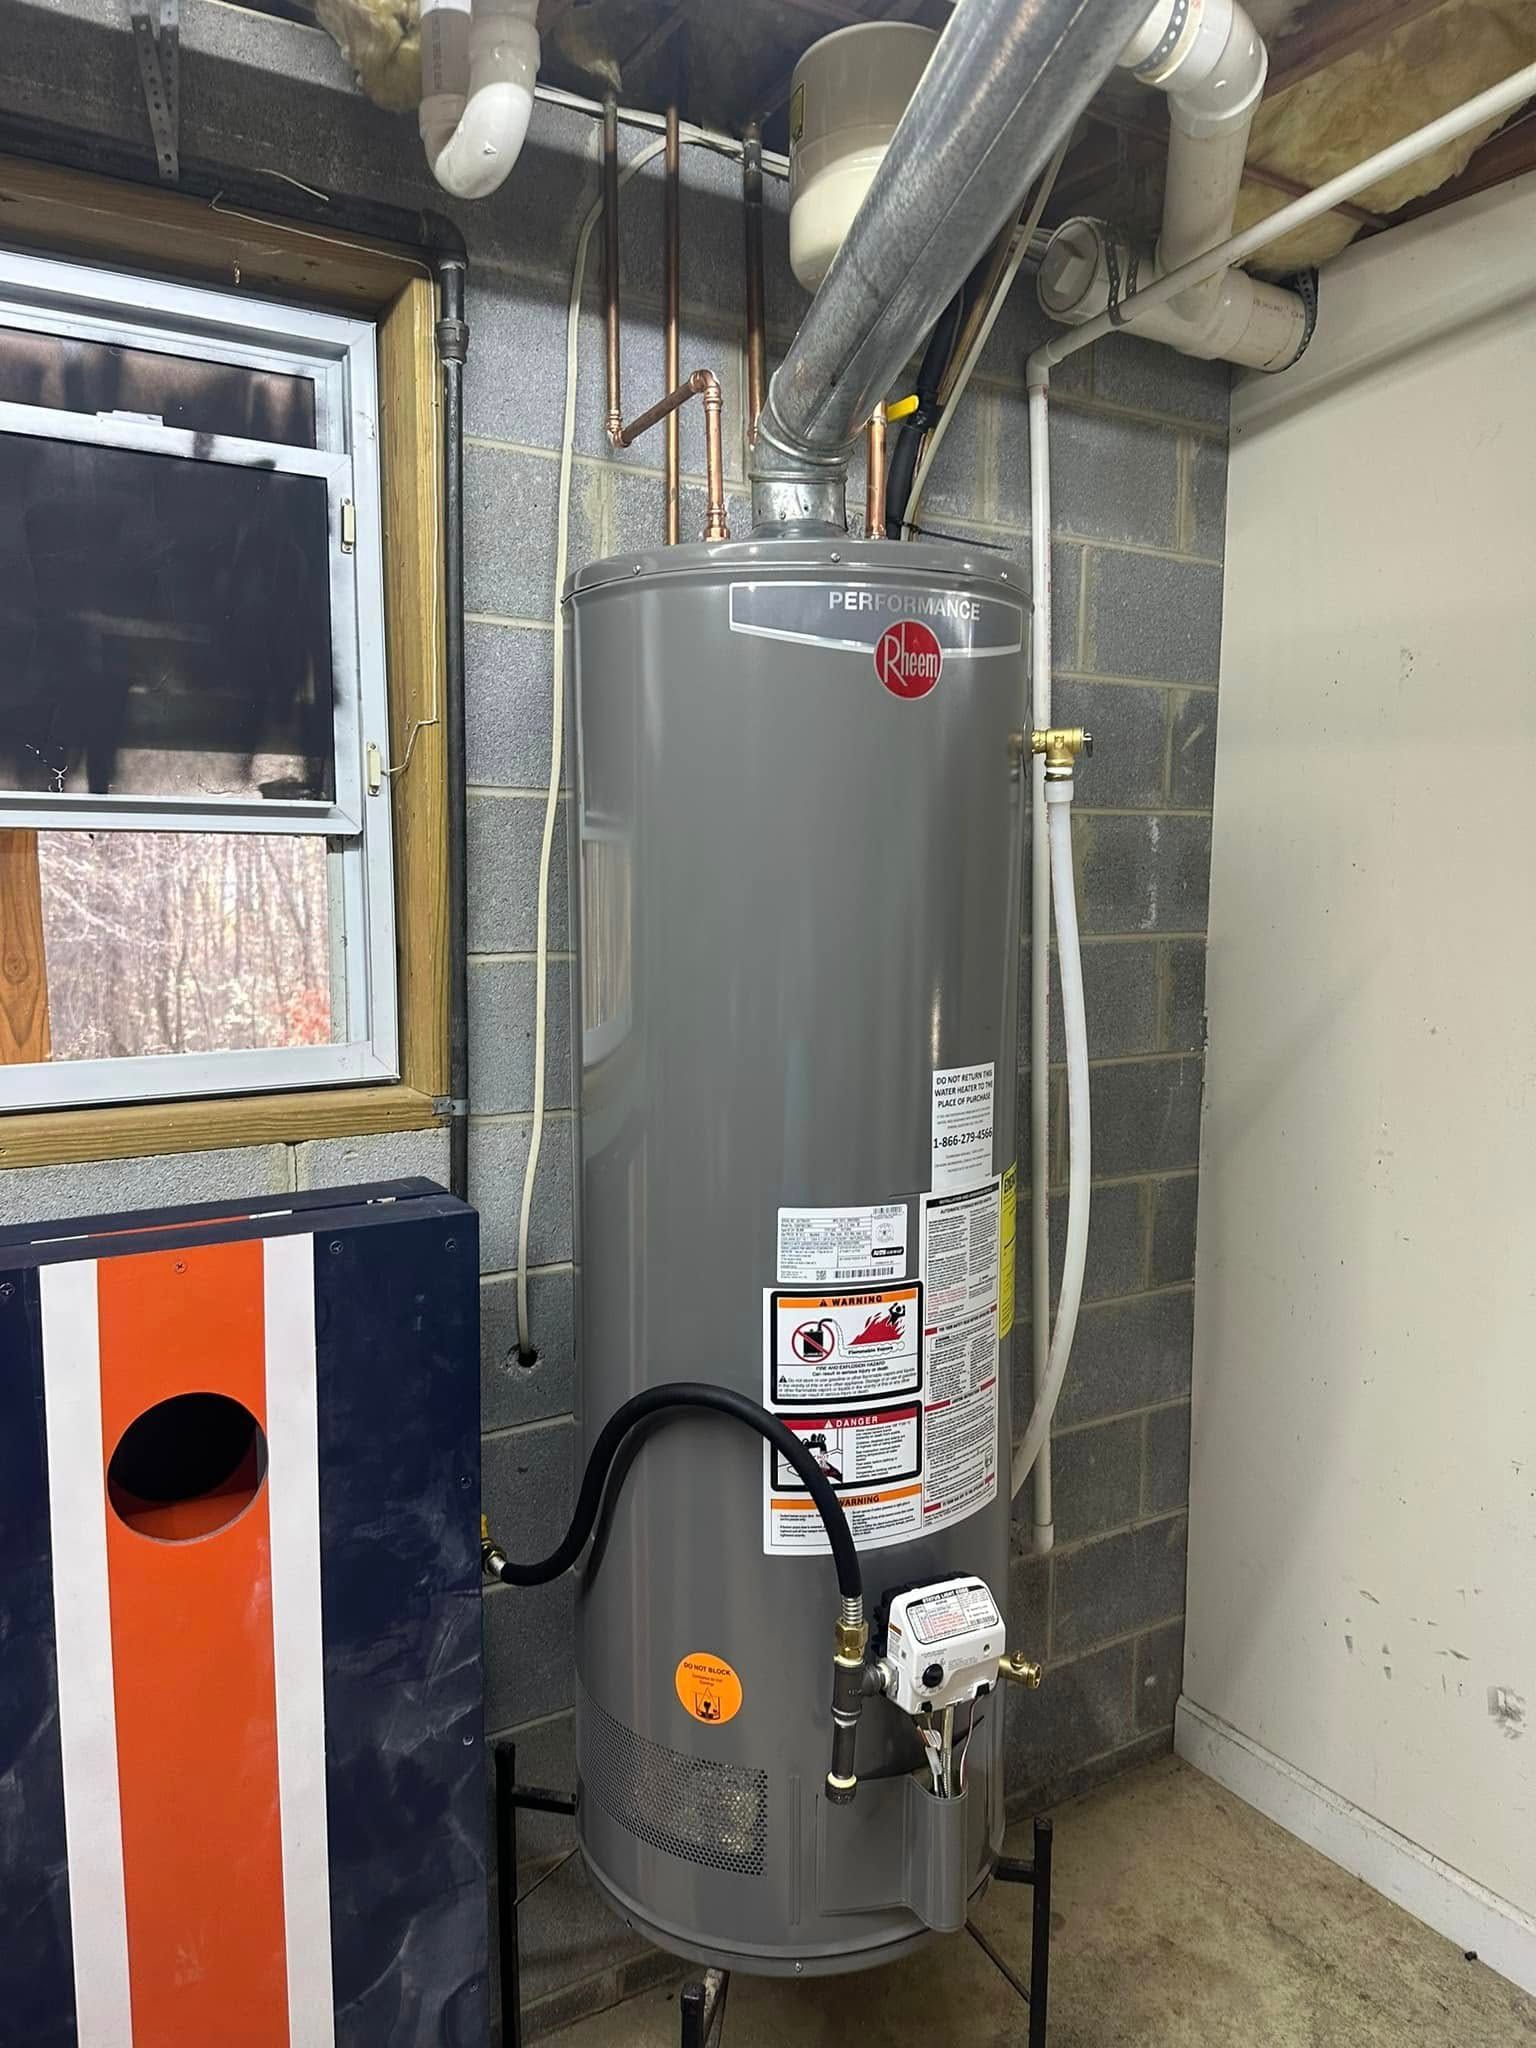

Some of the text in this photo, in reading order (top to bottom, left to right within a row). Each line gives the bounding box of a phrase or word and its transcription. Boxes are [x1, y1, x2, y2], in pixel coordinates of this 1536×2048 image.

[829, 591, 980, 621] PERFORMANCE
[884, 623, 938, 687] Rheem
[936, 1069, 992, 1085] DO NOT RETURN THIS
[934, 1087, 956, 1097] WATER
[957, 1083, 977, 1094] HEATER
[978, 1082, 984, 1090] TO
[937, 1092, 990, 1108] PLACE OF PURCHASE
[933, 1127, 992, 1149] 1-866-279-4566
[832, 1295, 882, 1306] WARNING
[836, 1416, 878, 1427] DANGER
[683, 1662, 731, 1677] DO NOT BLOCK
